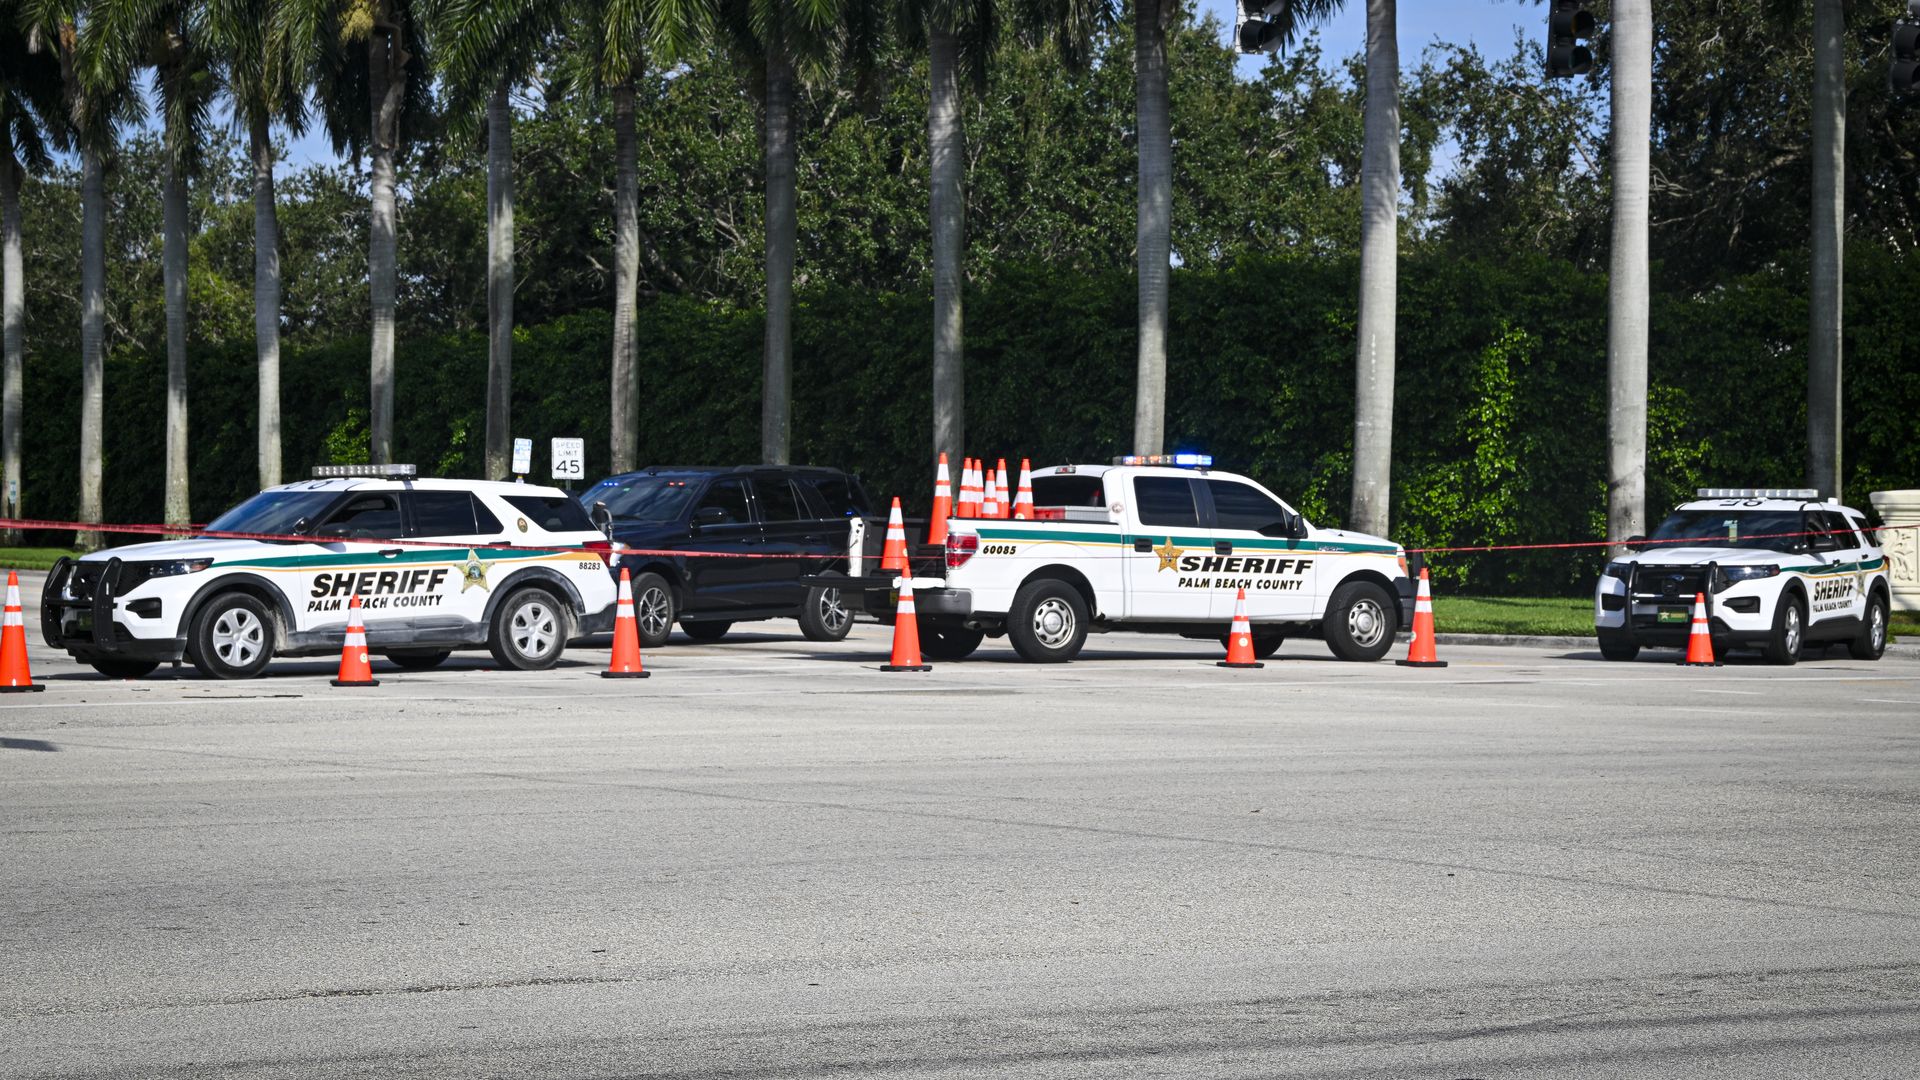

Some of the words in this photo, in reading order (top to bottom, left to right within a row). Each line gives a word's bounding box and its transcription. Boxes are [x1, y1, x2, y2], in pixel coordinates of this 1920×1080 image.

[556, 460, 580, 473] 45
[983, 545, 1016, 554] 60085
[579, 562, 600, 570] 88283
[1180, 556, 1313, 575] SHERIFF
[310, 569, 448, 598] SHERIFF
[1178, 577, 1210, 588] PALM
[1214, 578, 1251, 590] BEACH
[1256, 579, 1303, 591] COUNTY
[1814, 578, 1853, 601] SHERIFF
[307, 599, 341, 612] PALM
[347, 597, 388, 610] ACH
[393, 595, 443, 608] COUNTY
